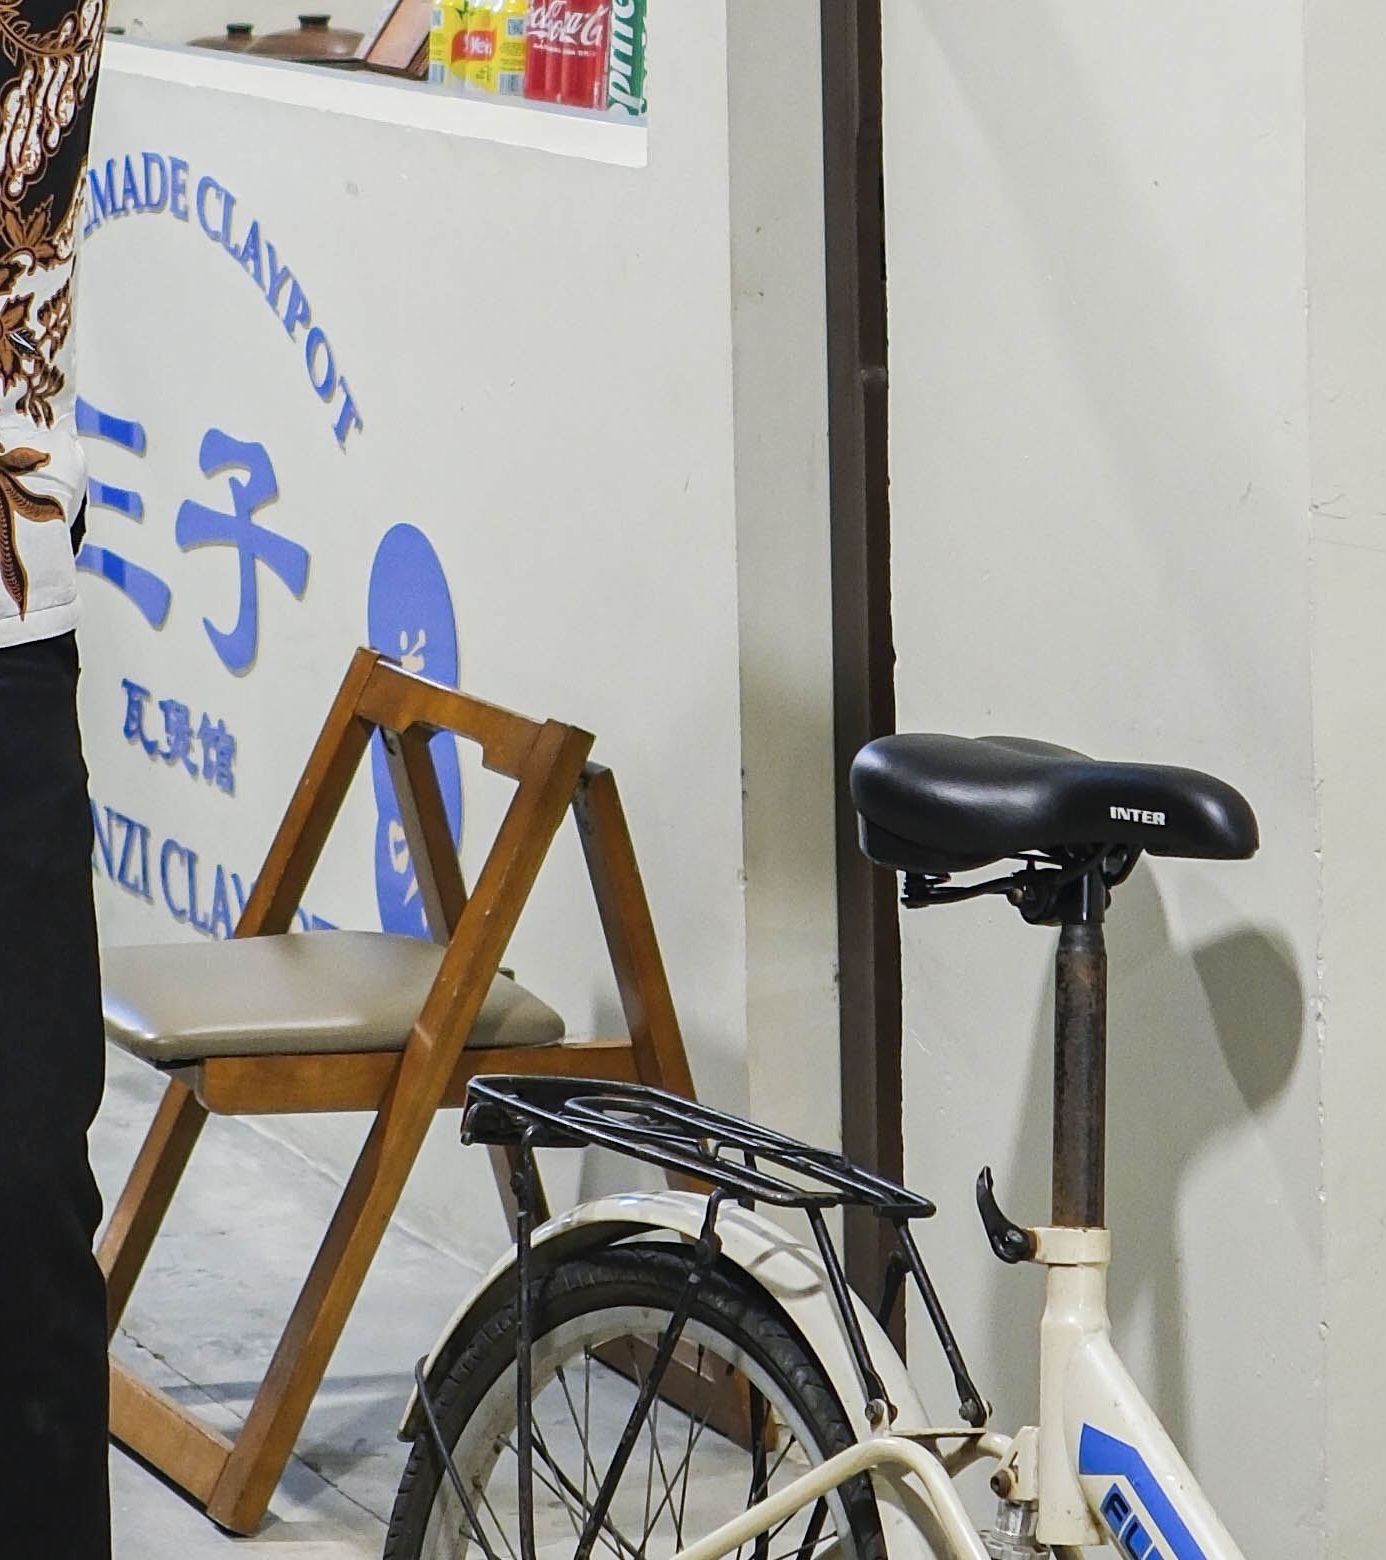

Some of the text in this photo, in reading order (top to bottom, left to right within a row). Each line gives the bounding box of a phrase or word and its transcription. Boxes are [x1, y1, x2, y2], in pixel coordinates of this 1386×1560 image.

[83, 151, 363, 454] MADE CLAYPOT
[1109, 806, 1166, 826] INTER
